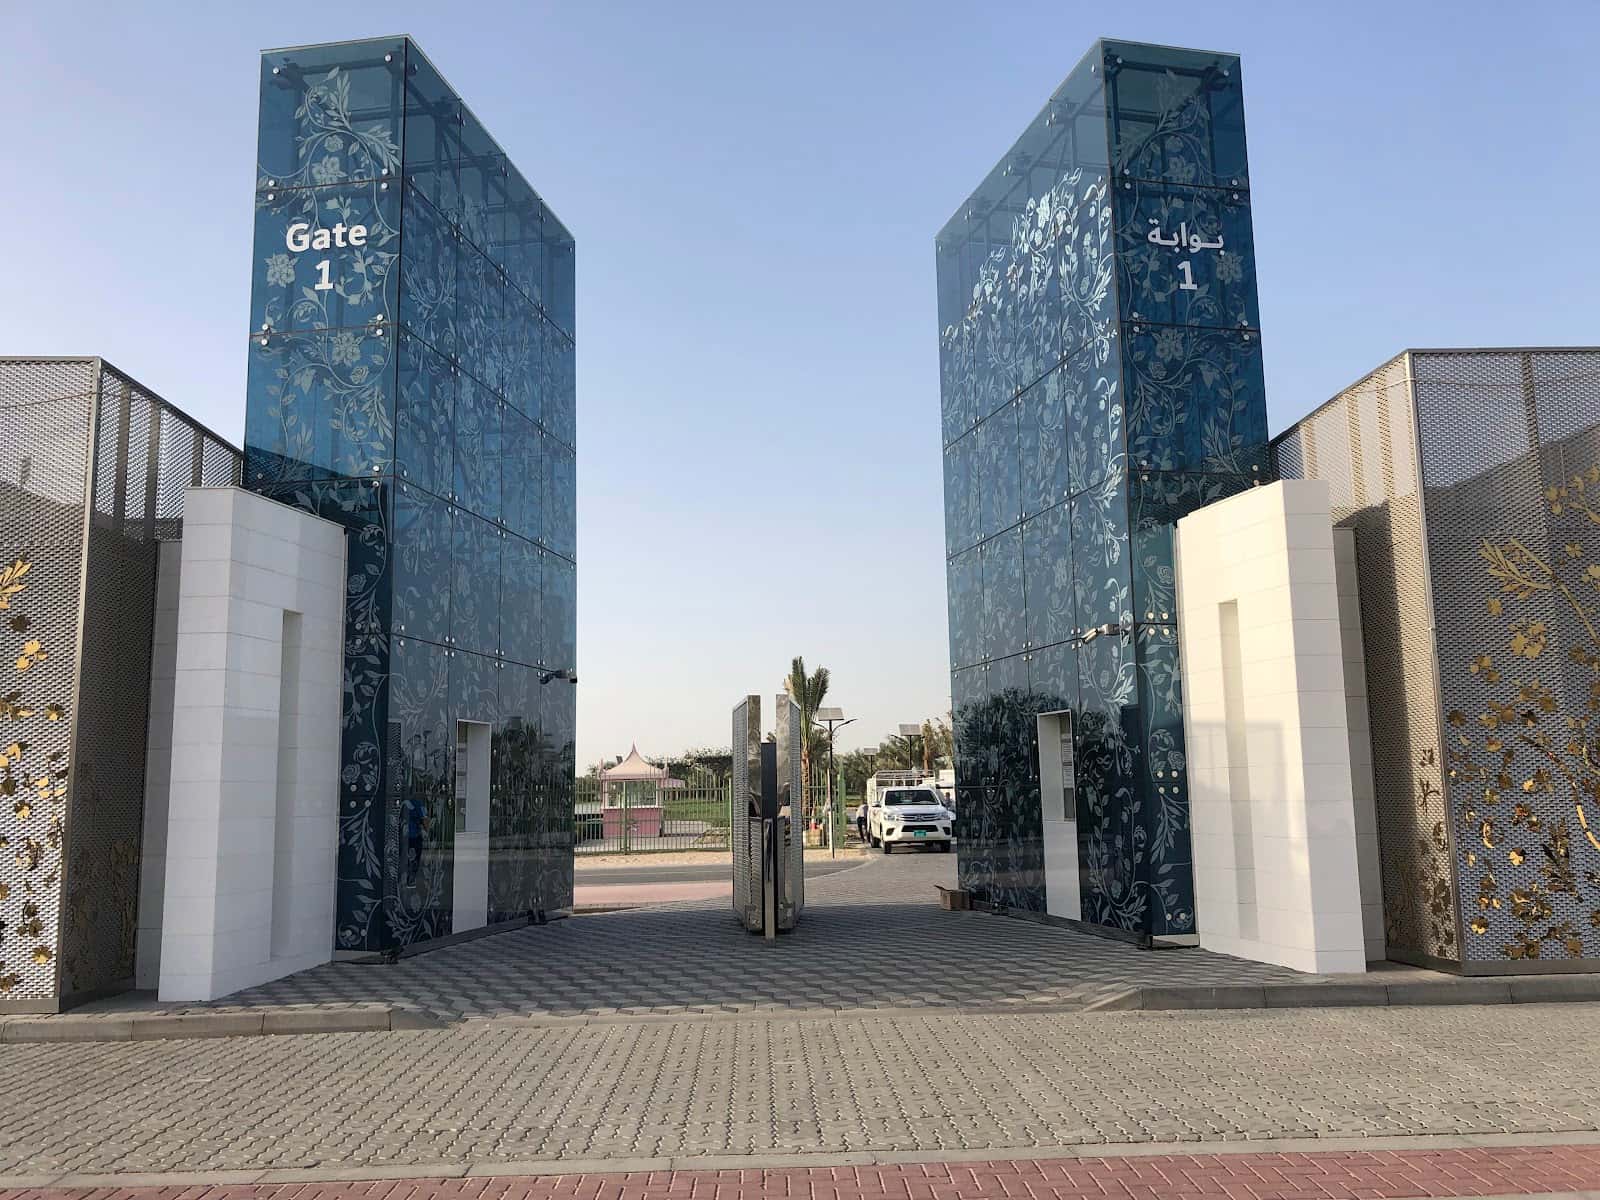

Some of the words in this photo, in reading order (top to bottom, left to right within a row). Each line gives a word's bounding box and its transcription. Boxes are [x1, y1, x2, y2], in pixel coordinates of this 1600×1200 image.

[286, 222, 367, 252] Gate
[1147, 217, 1225, 256] بوابة
[314, 259, 334, 291] 1
[1177, 260, 1198, 290] 1
